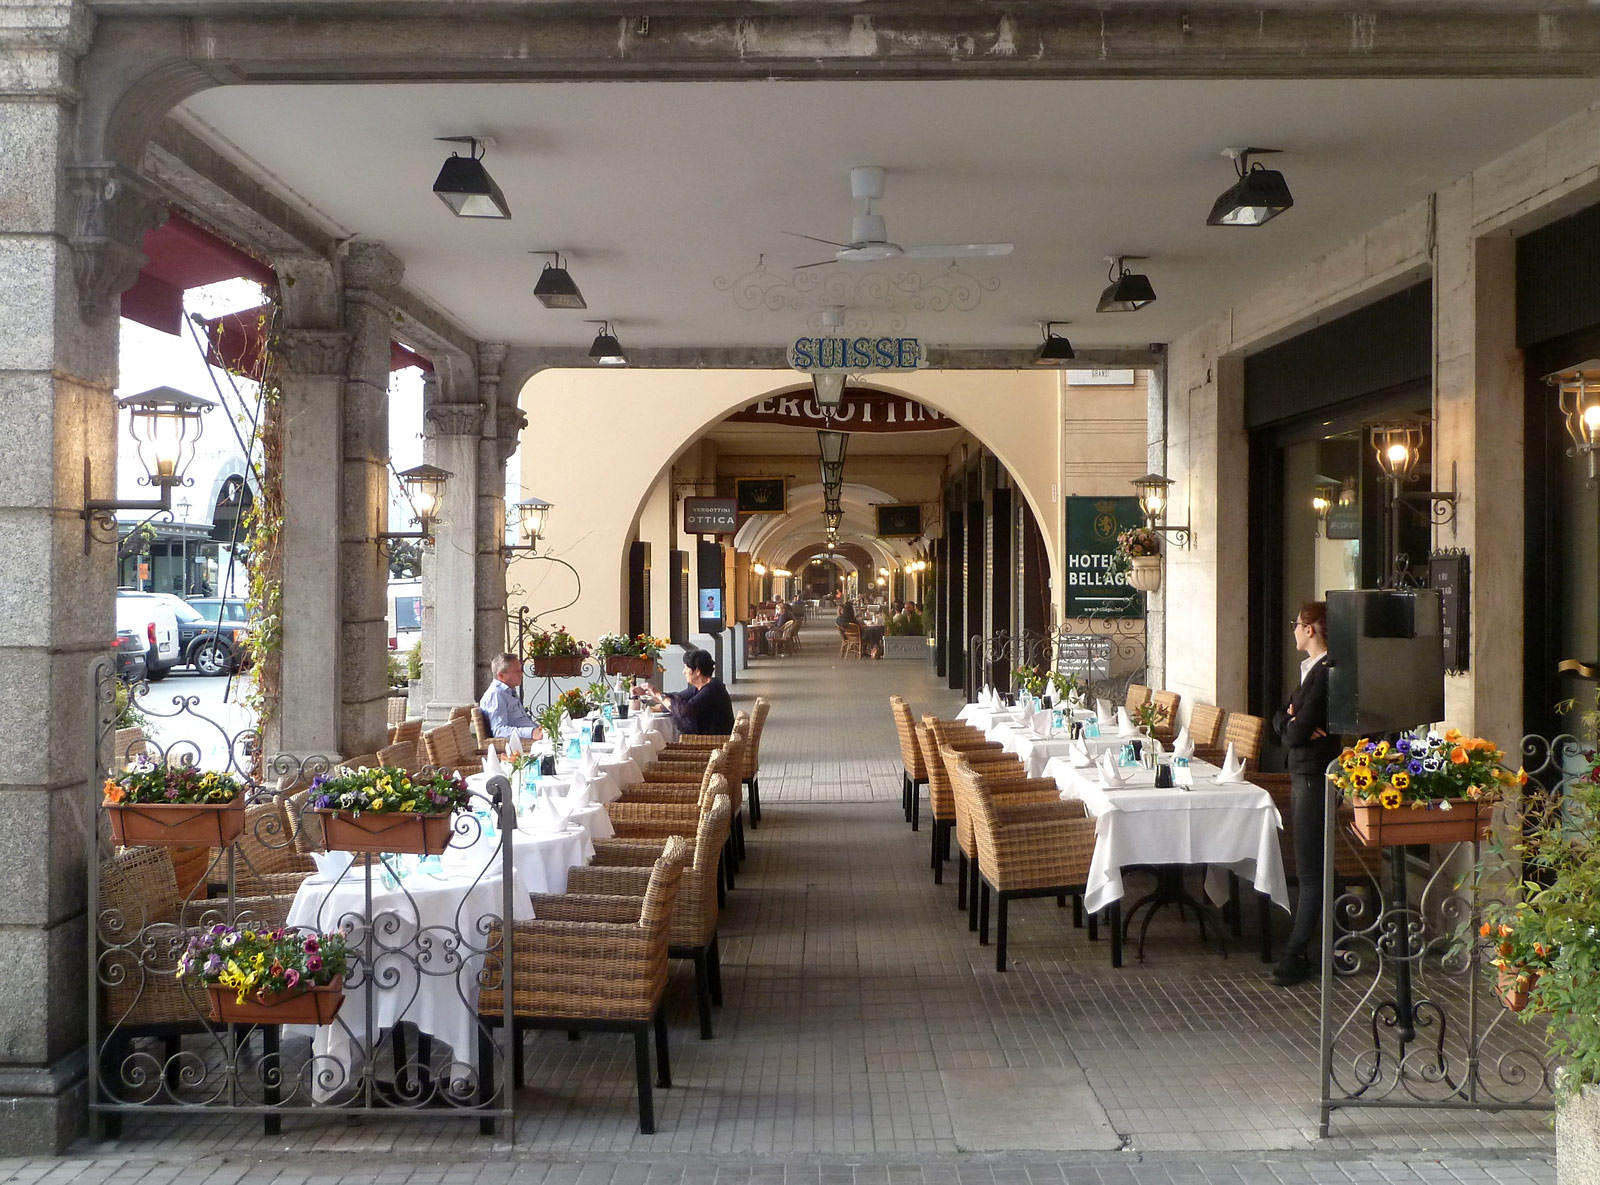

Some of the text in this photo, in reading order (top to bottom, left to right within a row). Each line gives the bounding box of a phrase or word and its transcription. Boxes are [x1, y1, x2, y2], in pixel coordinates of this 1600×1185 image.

[794, 337, 922, 369] SUISSE
[738, 397, 950, 423] ERGOTTIN
[688, 516, 735, 524] OTTICA
